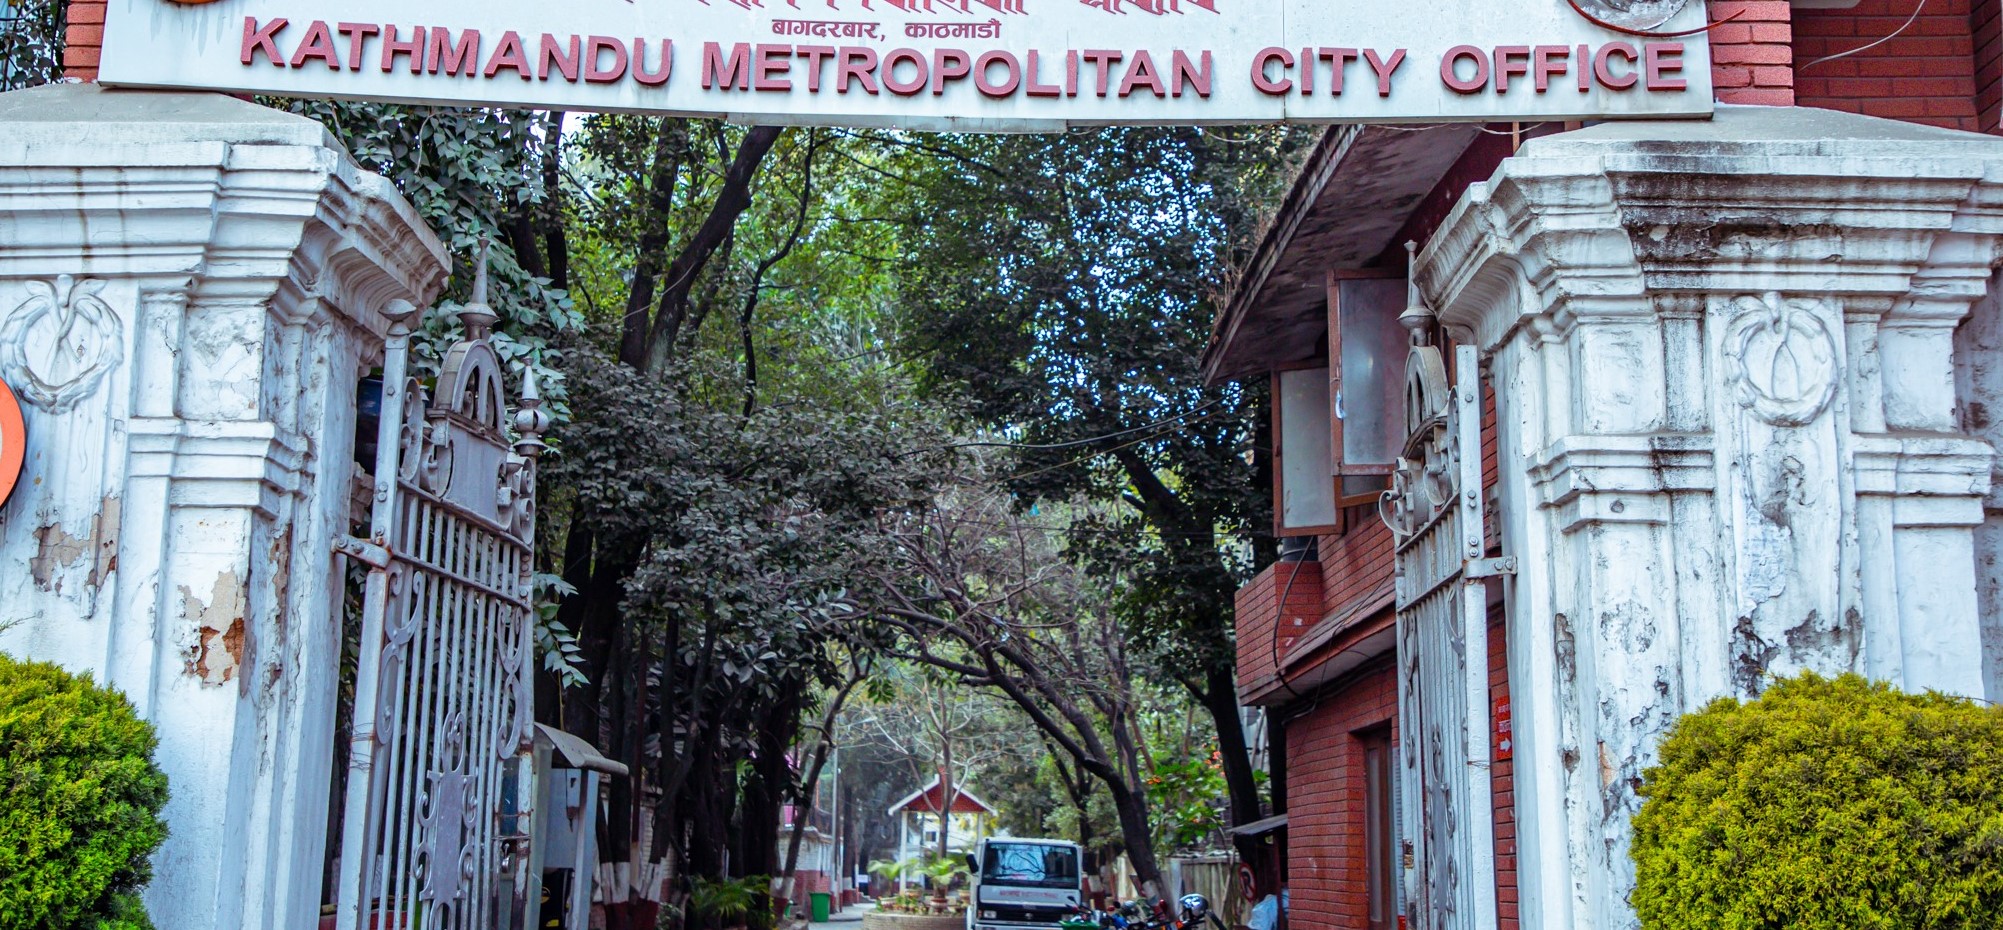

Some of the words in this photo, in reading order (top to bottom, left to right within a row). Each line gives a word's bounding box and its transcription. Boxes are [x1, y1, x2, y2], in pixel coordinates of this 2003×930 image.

[772, 19, 885, 41] बागदरबार,
[241, 17, 672, 86] KATHMANDU
[702, 42, 1211, 98] METROPOLITAN
[1251, 47, 1407, 97] CITY
[1441, 41, 1687, 94] OFFICE
